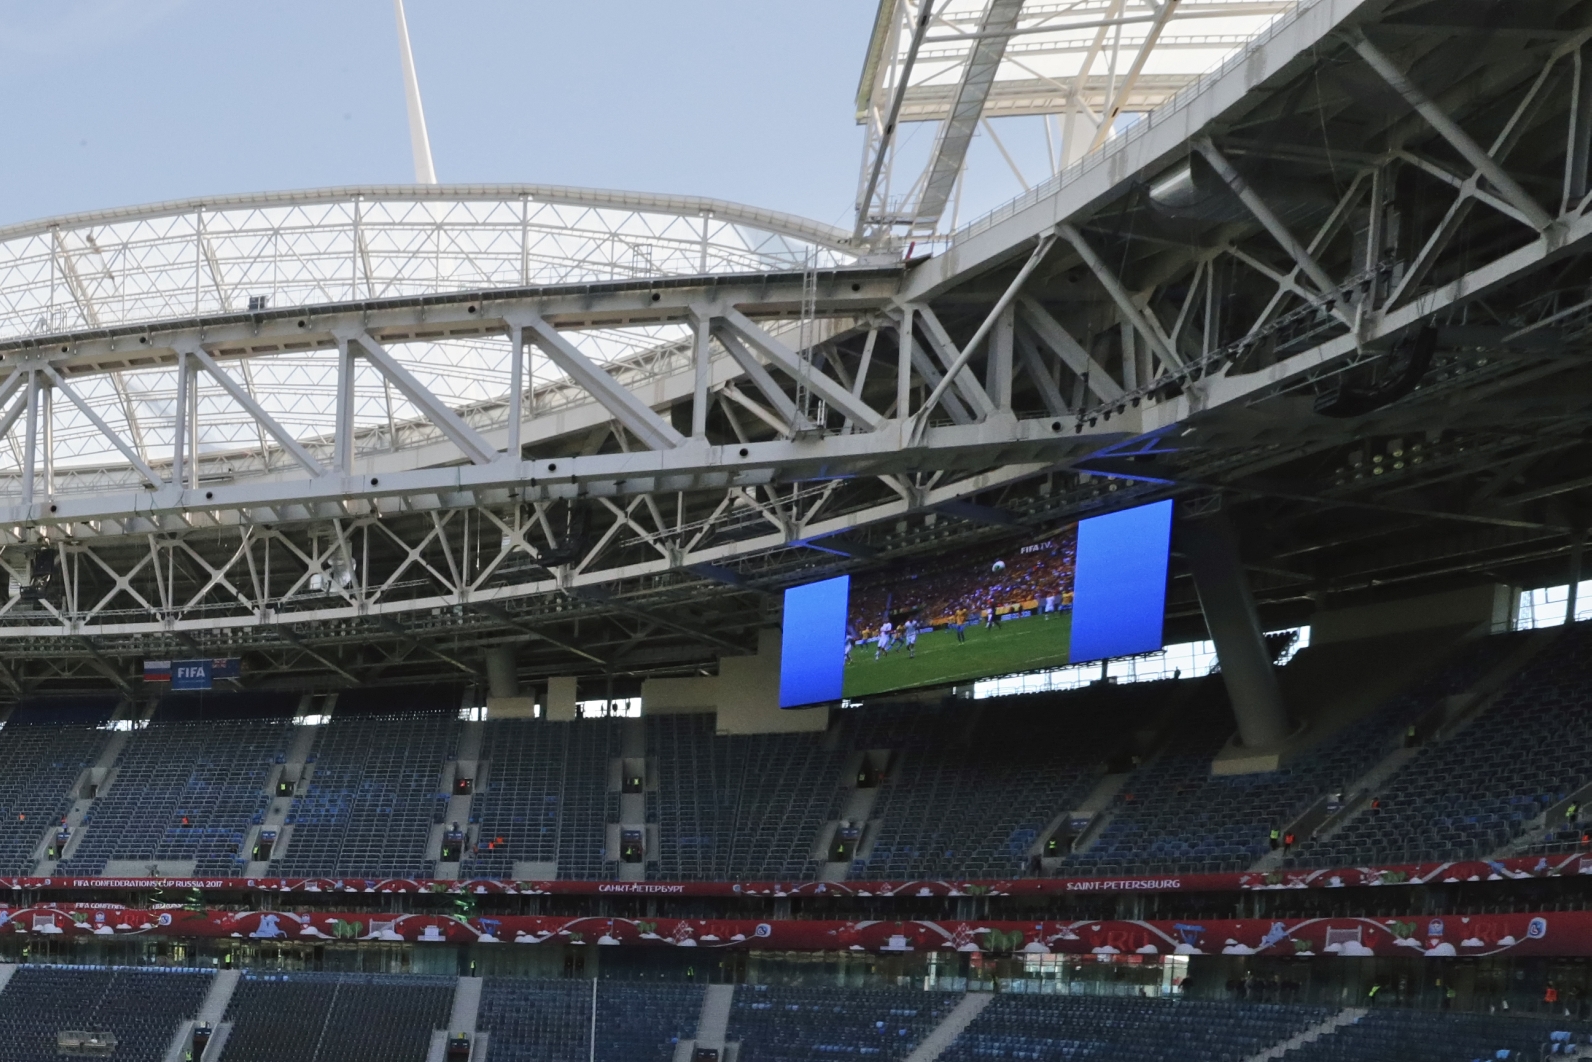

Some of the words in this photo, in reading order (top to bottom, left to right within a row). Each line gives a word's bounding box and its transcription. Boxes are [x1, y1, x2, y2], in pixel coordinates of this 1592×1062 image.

[1020, 544, 1039, 554] FIFA
[178, 667, 205, 678] FIFA
[598, 884, 685, 893] САНКТ-ПЕТЕРБУРГ
[1066, 879, 1180, 891] SAINT-PETERSBURG
